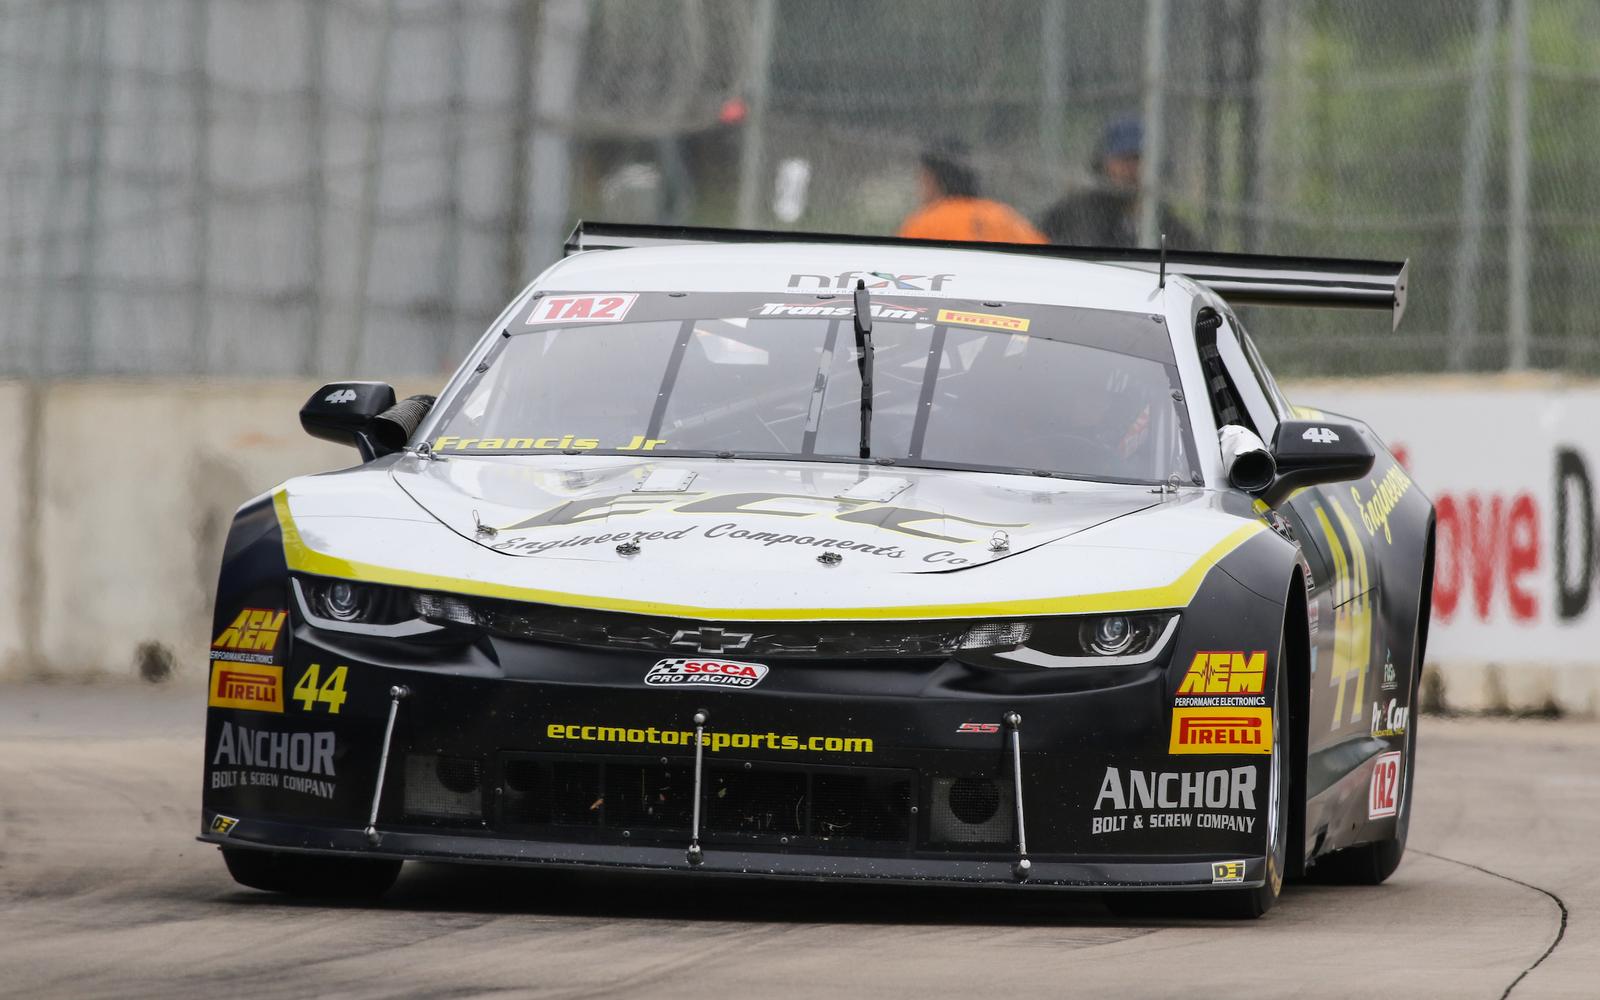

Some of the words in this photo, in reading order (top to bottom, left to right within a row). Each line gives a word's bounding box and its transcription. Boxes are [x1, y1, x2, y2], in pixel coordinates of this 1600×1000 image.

[544, 297, 625, 320] TA2
[944, 311, 1022, 328] PIRELLI
[432, 435, 599, 451] Francis
[616, 434, 668, 451] Jr
[490, 514, 699, 555] Engineered
[703, 522, 904, 559] Components
[1389, 442, 1541, 622] ove
[1553, 444, 1600, 624] D
[213, 610, 286, 651] AEM
[648, 675, 686, 686] PRO
[691, 675, 754, 687] RACING
[684, 660, 757, 678] SCCA
[1175, 651, 1268, 695] AEM
[217, 670, 278, 703] PIRELLI
[292, 663, 348, 714] 44
[1174, 697, 1220, 706] PERFORMANCE
[1220, 697, 1266, 706] ELECTRONICS
[547, 723, 874, 754] eccmotorsports.com
[1178, 717, 1262, 745] PIRELLI
[213, 721, 336, 776] ANCHOR
[212, 770, 237, 789] BOLT
[240, 770, 248, 786] &
[251, 771, 279, 787] SCREW
[283, 775, 336, 799] COMPANY
[1093, 766, 1257, 810] ANCHOR
[1374, 761, 1396, 810] TA2
[1092, 815, 1128, 835] BOLT
[1133, 815, 1144, 829] &
[1150, 814, 1193, 828] SCREW
[1196, 813, 1256, 834] COMPANY
